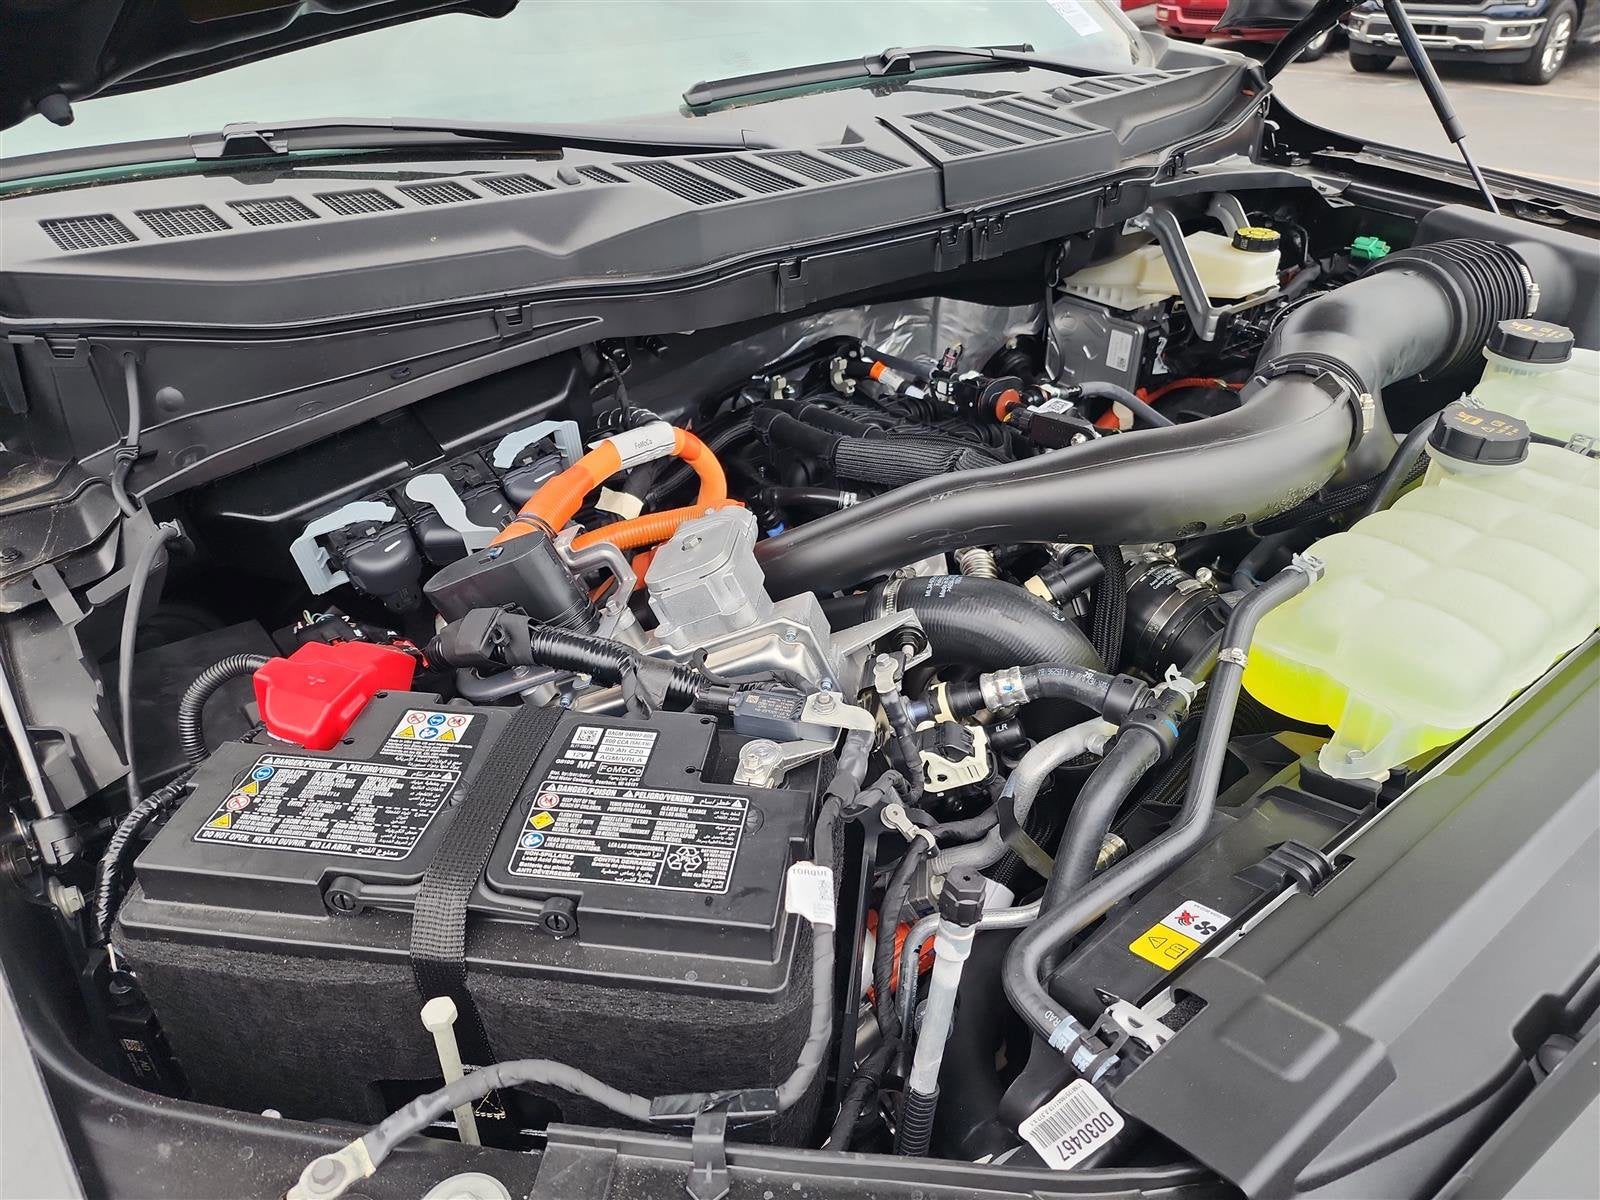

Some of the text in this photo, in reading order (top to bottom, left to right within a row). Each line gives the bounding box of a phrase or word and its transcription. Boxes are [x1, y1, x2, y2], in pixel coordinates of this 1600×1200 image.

[272, 757, 408, 775] DANGER/POISON PELIGRO/VENENO
[577, 761, 596, 769] MF
[600, 754, 642, 763] AGM/VRLA
[600, 764, 641, 775] FoMoCo
[556, 785, 694, 803] DANGER/POISON PELIGRO/VENENO
[200, 830, 354, 852] DO NOT OPEN. NE PAS OUVRIR. NO LA ABRA.
[523, 850, 574, 859] NON-SPILLABLE
[1044, 1010, 1061, 1027] RAD
[1056, 1111, 1114, 1161] 0030467
